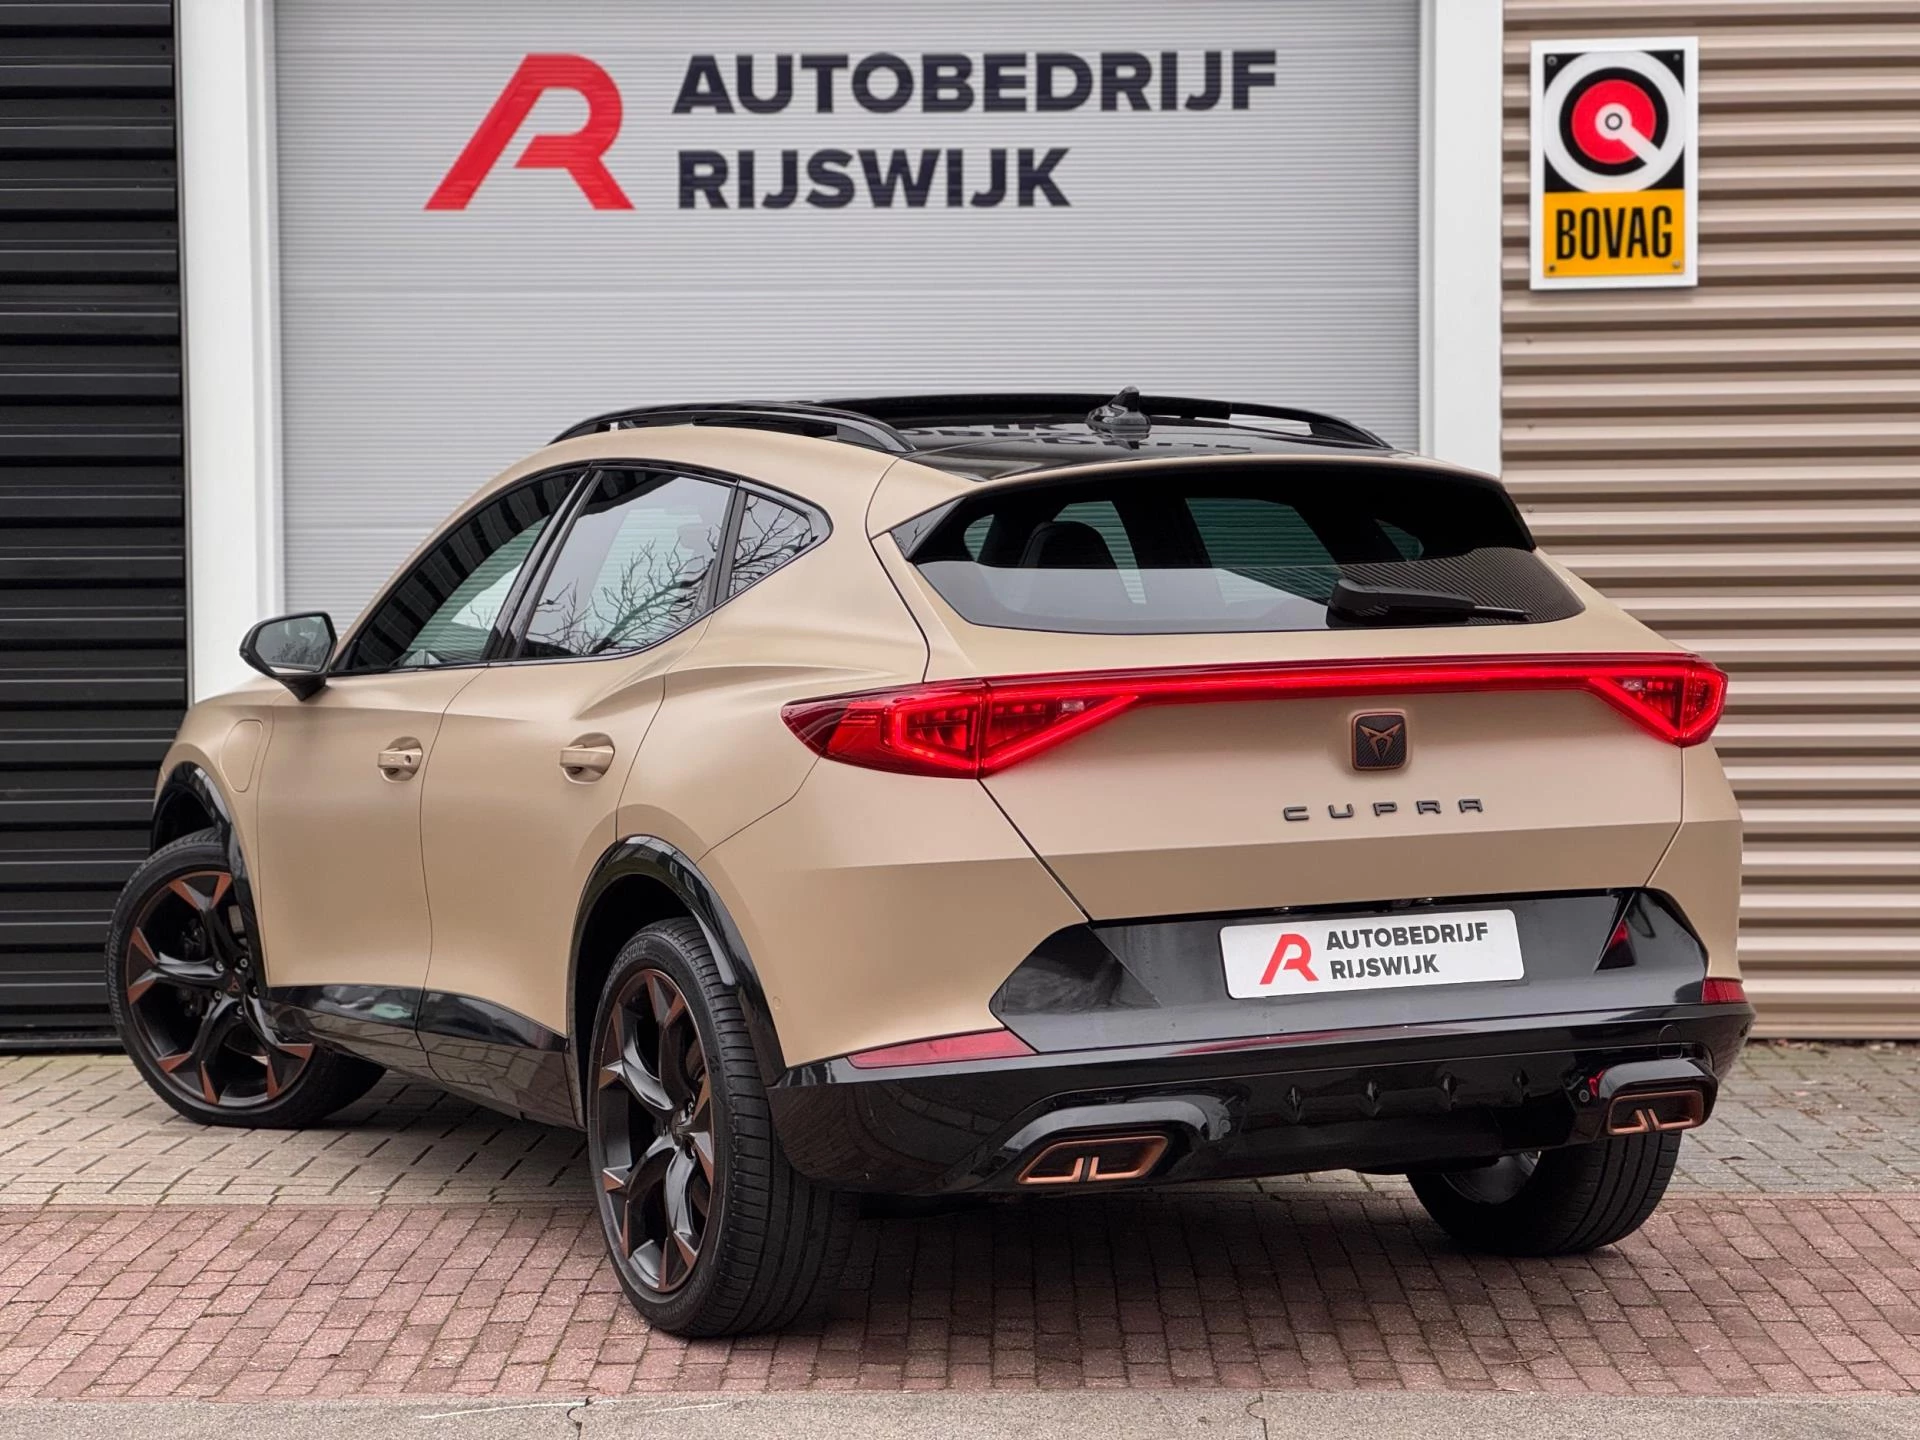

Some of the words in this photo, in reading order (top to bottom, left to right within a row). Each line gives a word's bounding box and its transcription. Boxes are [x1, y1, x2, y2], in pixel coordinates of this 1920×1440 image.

[673, 50, 1277, 115] AUTOBEDRIJF
[678, 149, 1072, 210] RIJSWIJK
[1556, 205, 1673, 261] BOVAG
[1283, 798, 1484, 823] CUPRA
[1326, 921, 1489, 951] AUTOBEDRIJF
[1330, 954, 1440, 980] RIJSWIJK
